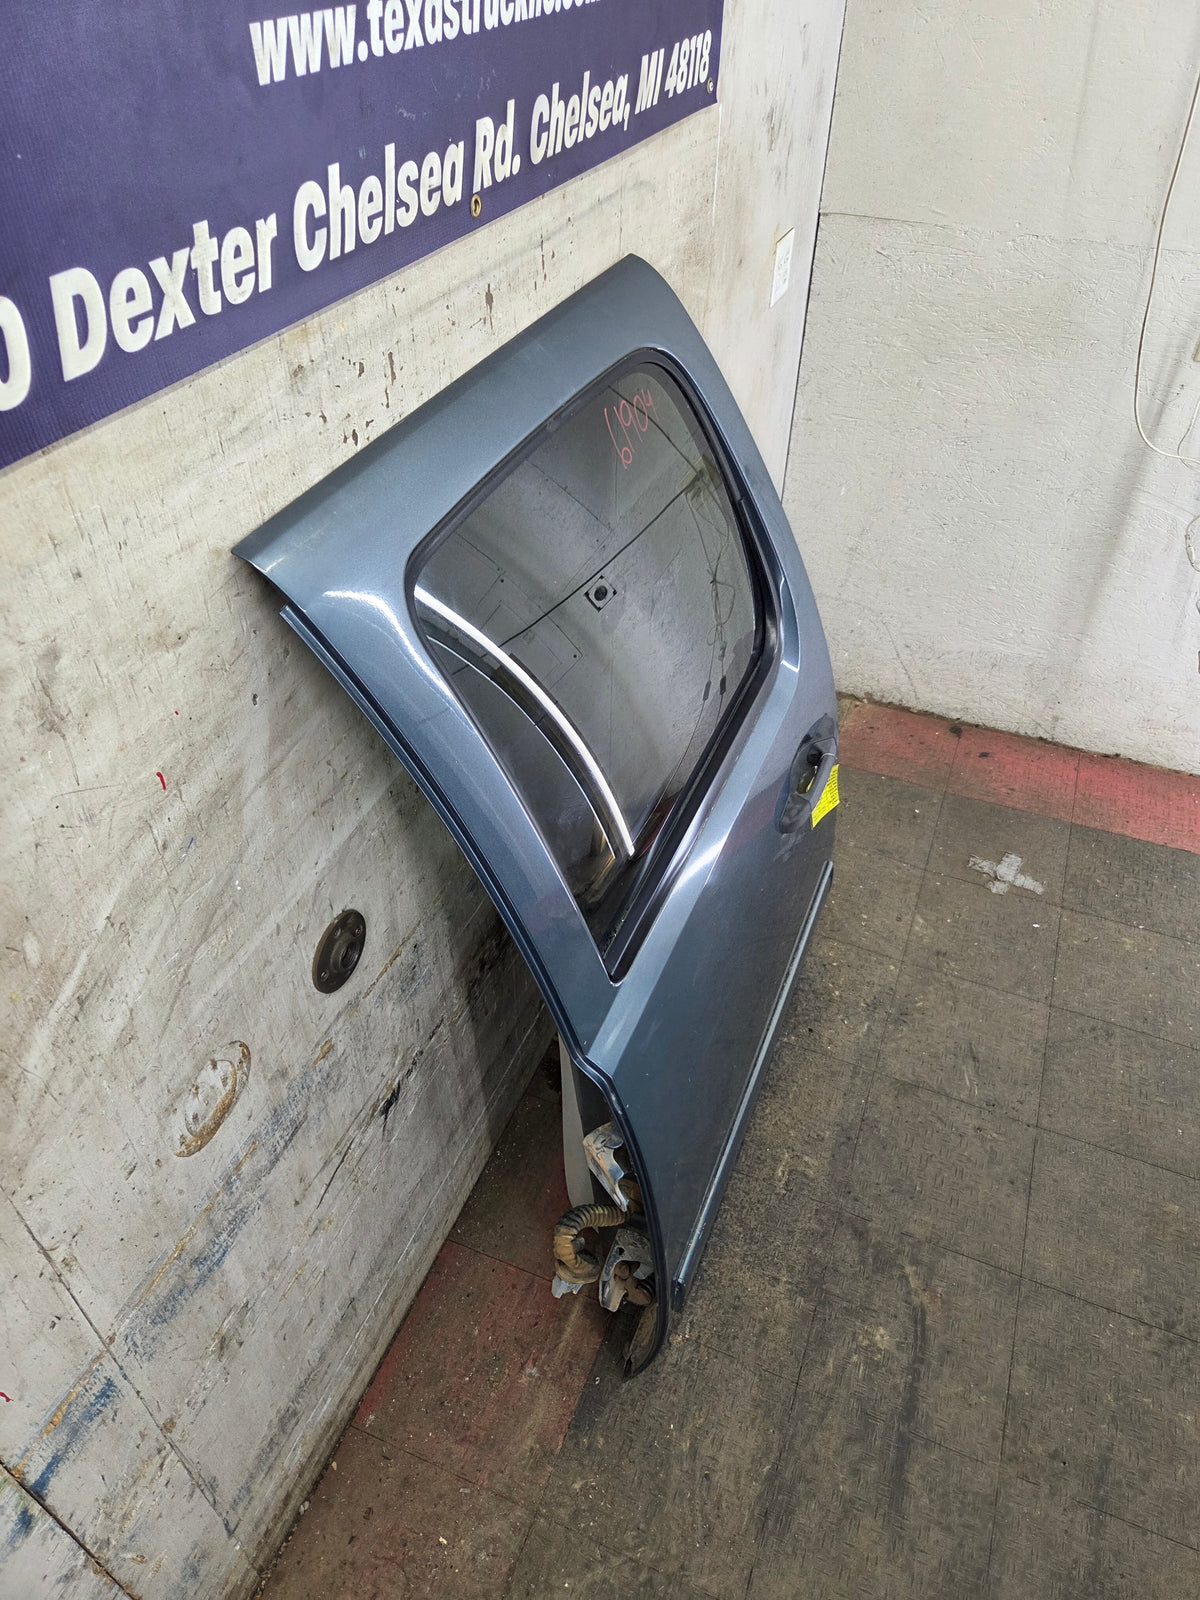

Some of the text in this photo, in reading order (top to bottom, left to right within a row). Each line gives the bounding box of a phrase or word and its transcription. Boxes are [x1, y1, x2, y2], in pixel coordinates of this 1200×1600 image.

[48, 212, 278, 383] Dexter
[293, 141, 465, 272] Chelsea
[472, 98, 521, 194] Rd.
[529, 70, 631, 166] Chelsea,
[634, 48, 665, 115] MI
[664, 29, 712, 99] 48118
